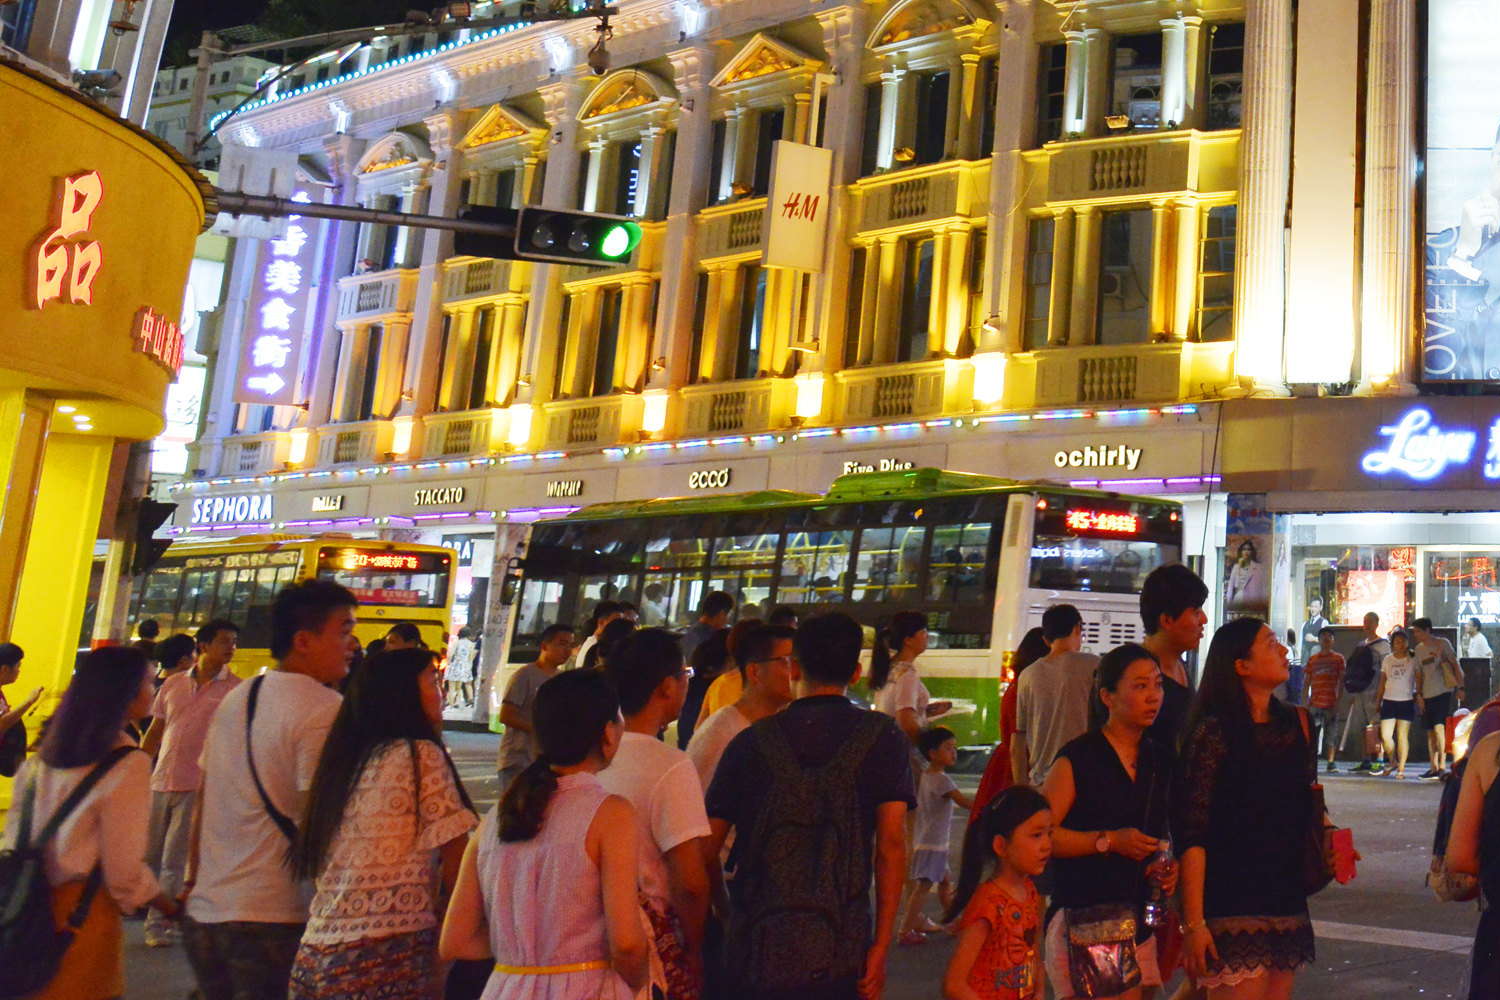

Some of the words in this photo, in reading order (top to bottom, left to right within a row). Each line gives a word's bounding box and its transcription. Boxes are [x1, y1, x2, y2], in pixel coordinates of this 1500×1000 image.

[782, 192, 819, 222] H&M
[1055, 445, 1141, 470] ochirly
[689, 469, 729, 489] ecco
[191, 494, 273, 523] SEPHORA
[414, 487, 463, 506] STACCATO
